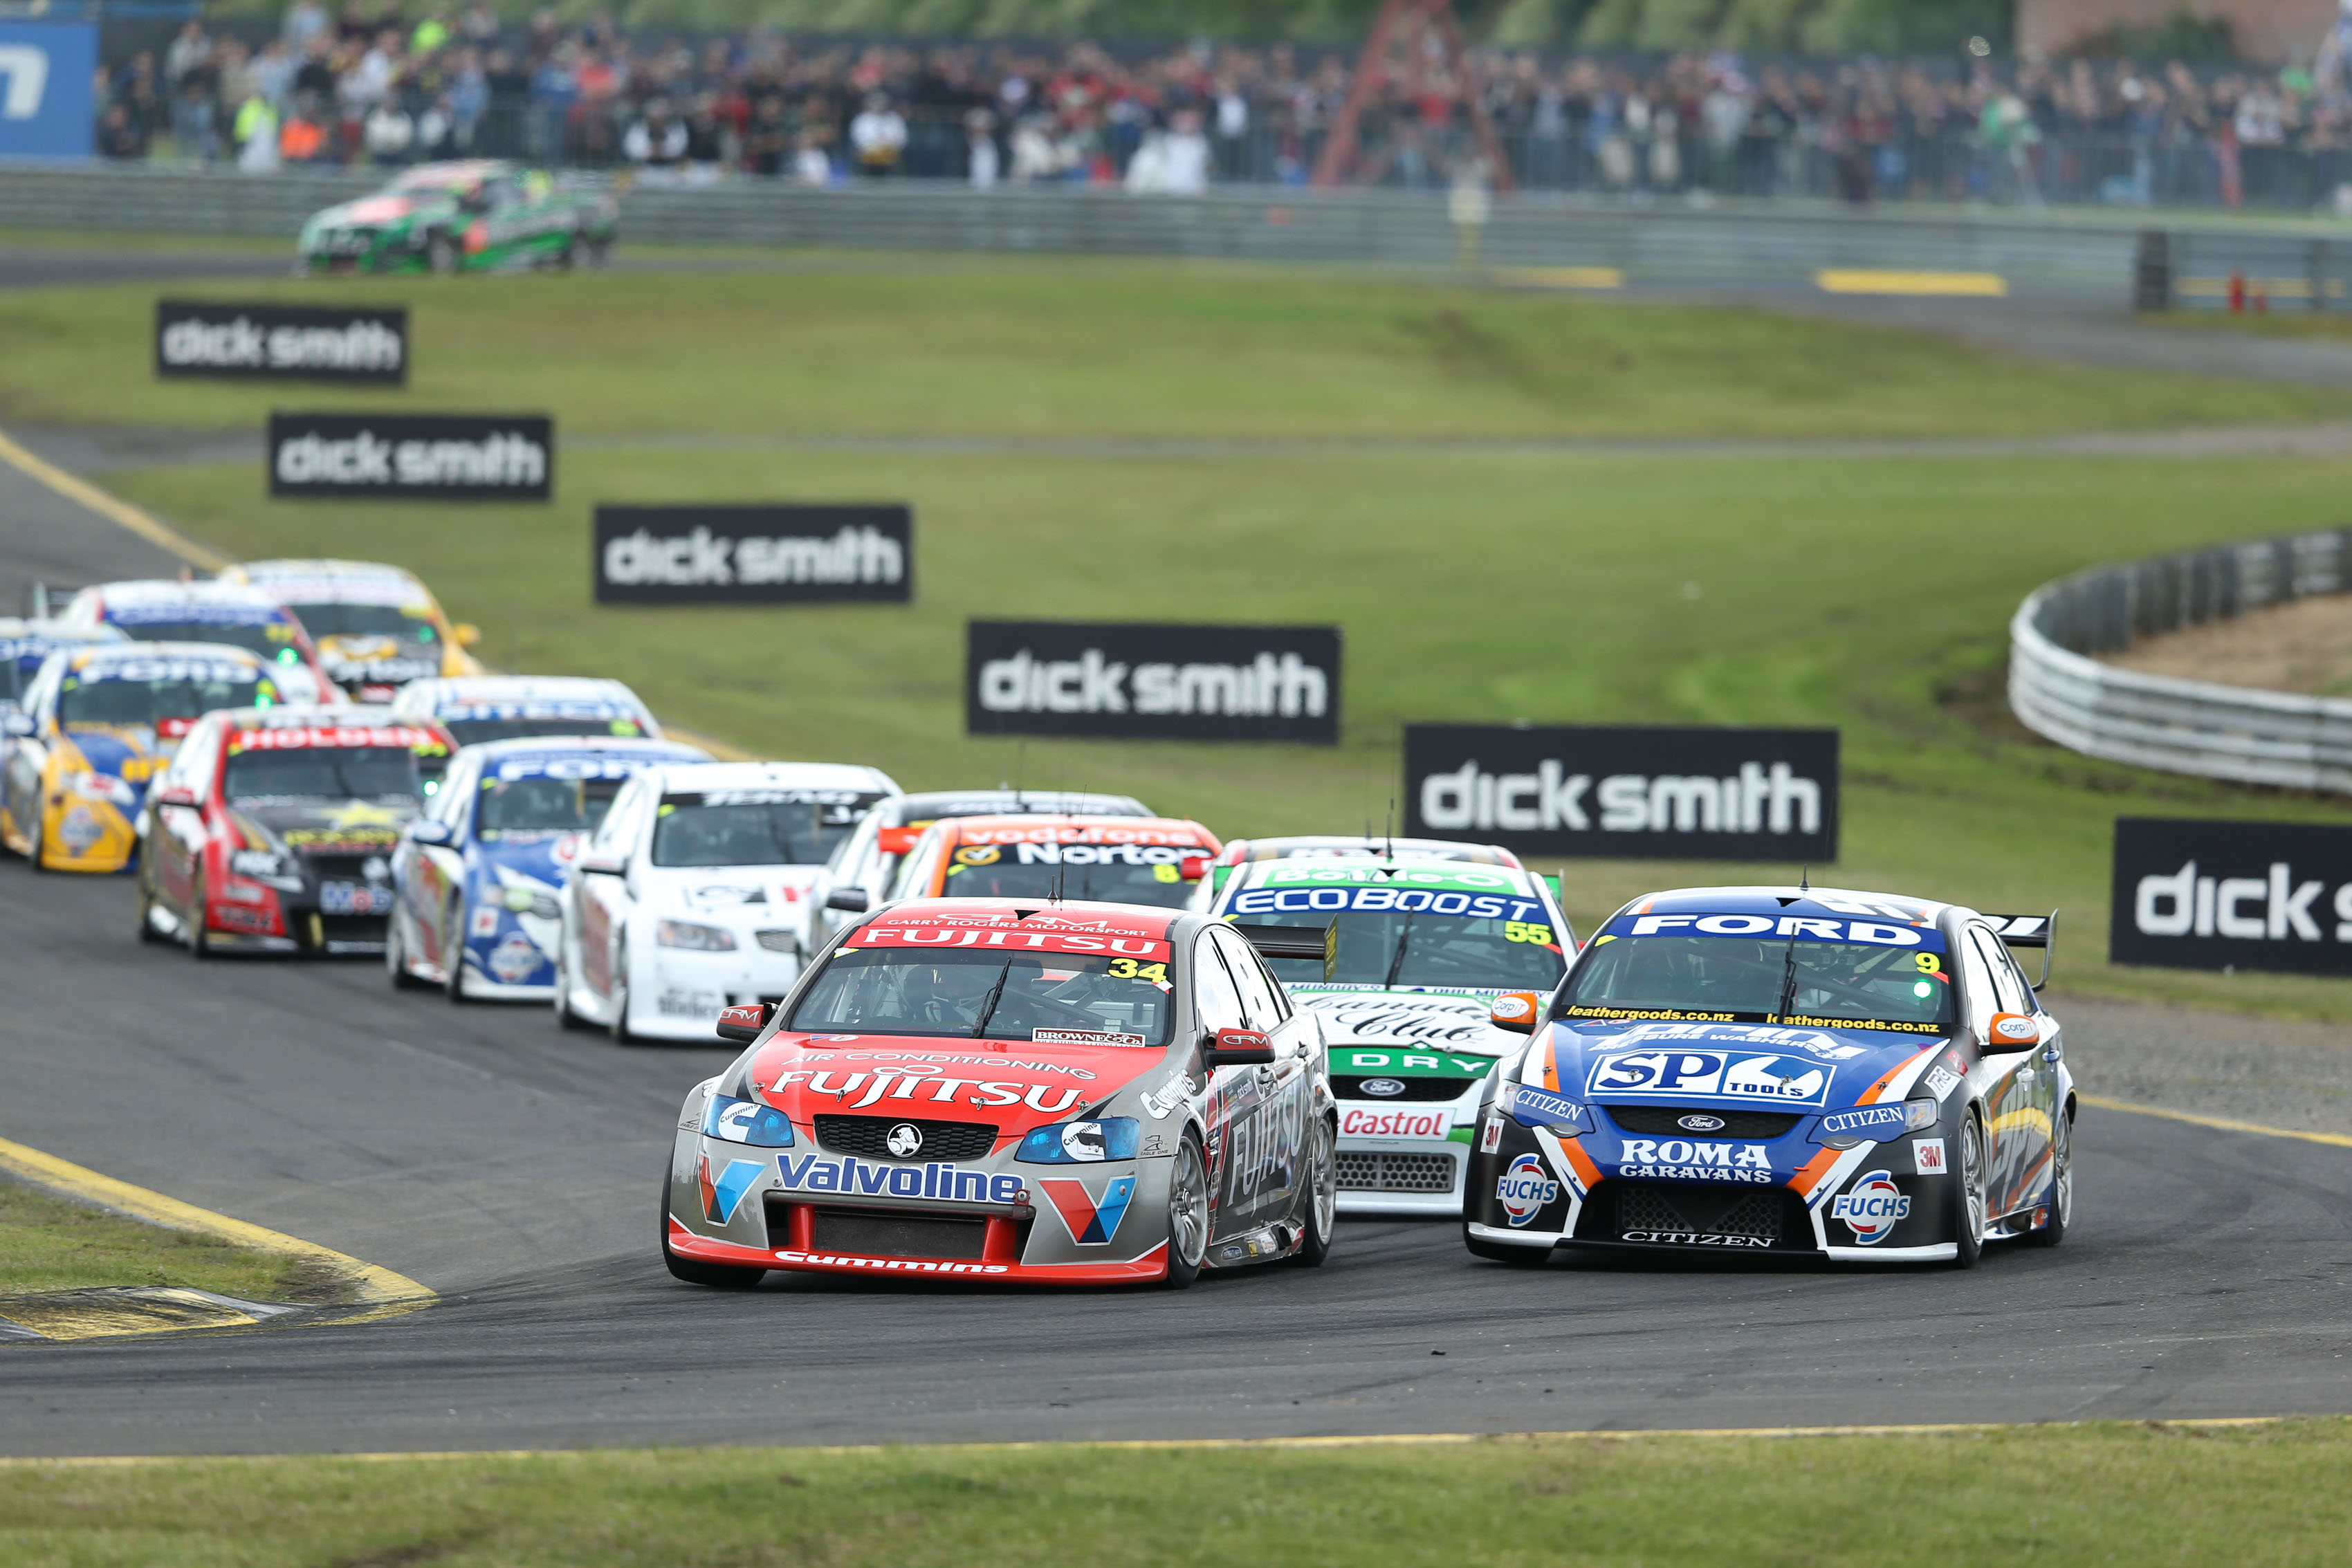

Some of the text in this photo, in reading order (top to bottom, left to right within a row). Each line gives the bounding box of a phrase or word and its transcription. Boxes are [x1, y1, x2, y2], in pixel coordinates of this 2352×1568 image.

[163, 317, 401, 369] dick smith
[278, 432, 545, 484] dick smith
[604, 527, 903, 584] dick smith
[979, 649, 1327, 717] dick smith
[241, 726, 433, 748] HOLDEN
[1420, 759, 1821, 834] dick smith
[963, 827, 1197, 847] vodafone
[1235, 888, 1540, 921] ECOBOOST
[2135, 860, 2324, 941] dick
[863, 928, 1159, 954] FUJITSU
[947, 920, 1020, 928] ROGERS
[1032, 923, 1148, 937] MOTORSPORT
[1504, 921, 1552, 946] 55
[1630, 914, 1922, 946] FORD
[1108, 958, 1168, 983] 34
[1914, 952, 1941, 974] 9
[1566, 1004, 1735, 1022] leathergoods.co.nz
[1222, 1034, 1269, 1048] GRM
[1709, 1034, 1820, 1053] WASHERS
[780, 1053, 1098, 1080] AIR CONDITIONING
[1352, 1053, 1488, 1072] DRY
[1598, 1052, 1721, 1089] SP
[768, 1070, 1086, 1113] FUJITSU
[1139, 1068, 1197, 1120] Cummins
[1369, 1080, 1395, 1094] Ford
[1729, 1082, 1804, 1098] TOOLS
[719, 1103, 759, 1123] Cummins
[1515, 1089, 1584, 1122] CITIZEN
[1343, 1109, 1442, 1136] Castrol
[1687, 1116, 1716, 1129] Ford
[1823, 1106, 1904, 1133] CITIZEN
[1063, 1123, 1099, 1147] Cummins
[1227, 1074, 1306, 1217] FUJITSU
[1485, 1125, 1500, 1146] 3M
[1620, 1139, 1773, 1170] ROMA
[1919, 1145, 1942, 1168] 3M
[776, 1153, 1025, 1203] Valvoline
[1619, 1165, 1772, 1183] CARAVANS
[1497, 1178, 1557, 1201] FUCHS
[1833, 1197, 1910, 1217] FUCHS
[1622, 1231, 1776, 1247] CITIZEN
[775, 1250, 1009, 1273] Cummins
